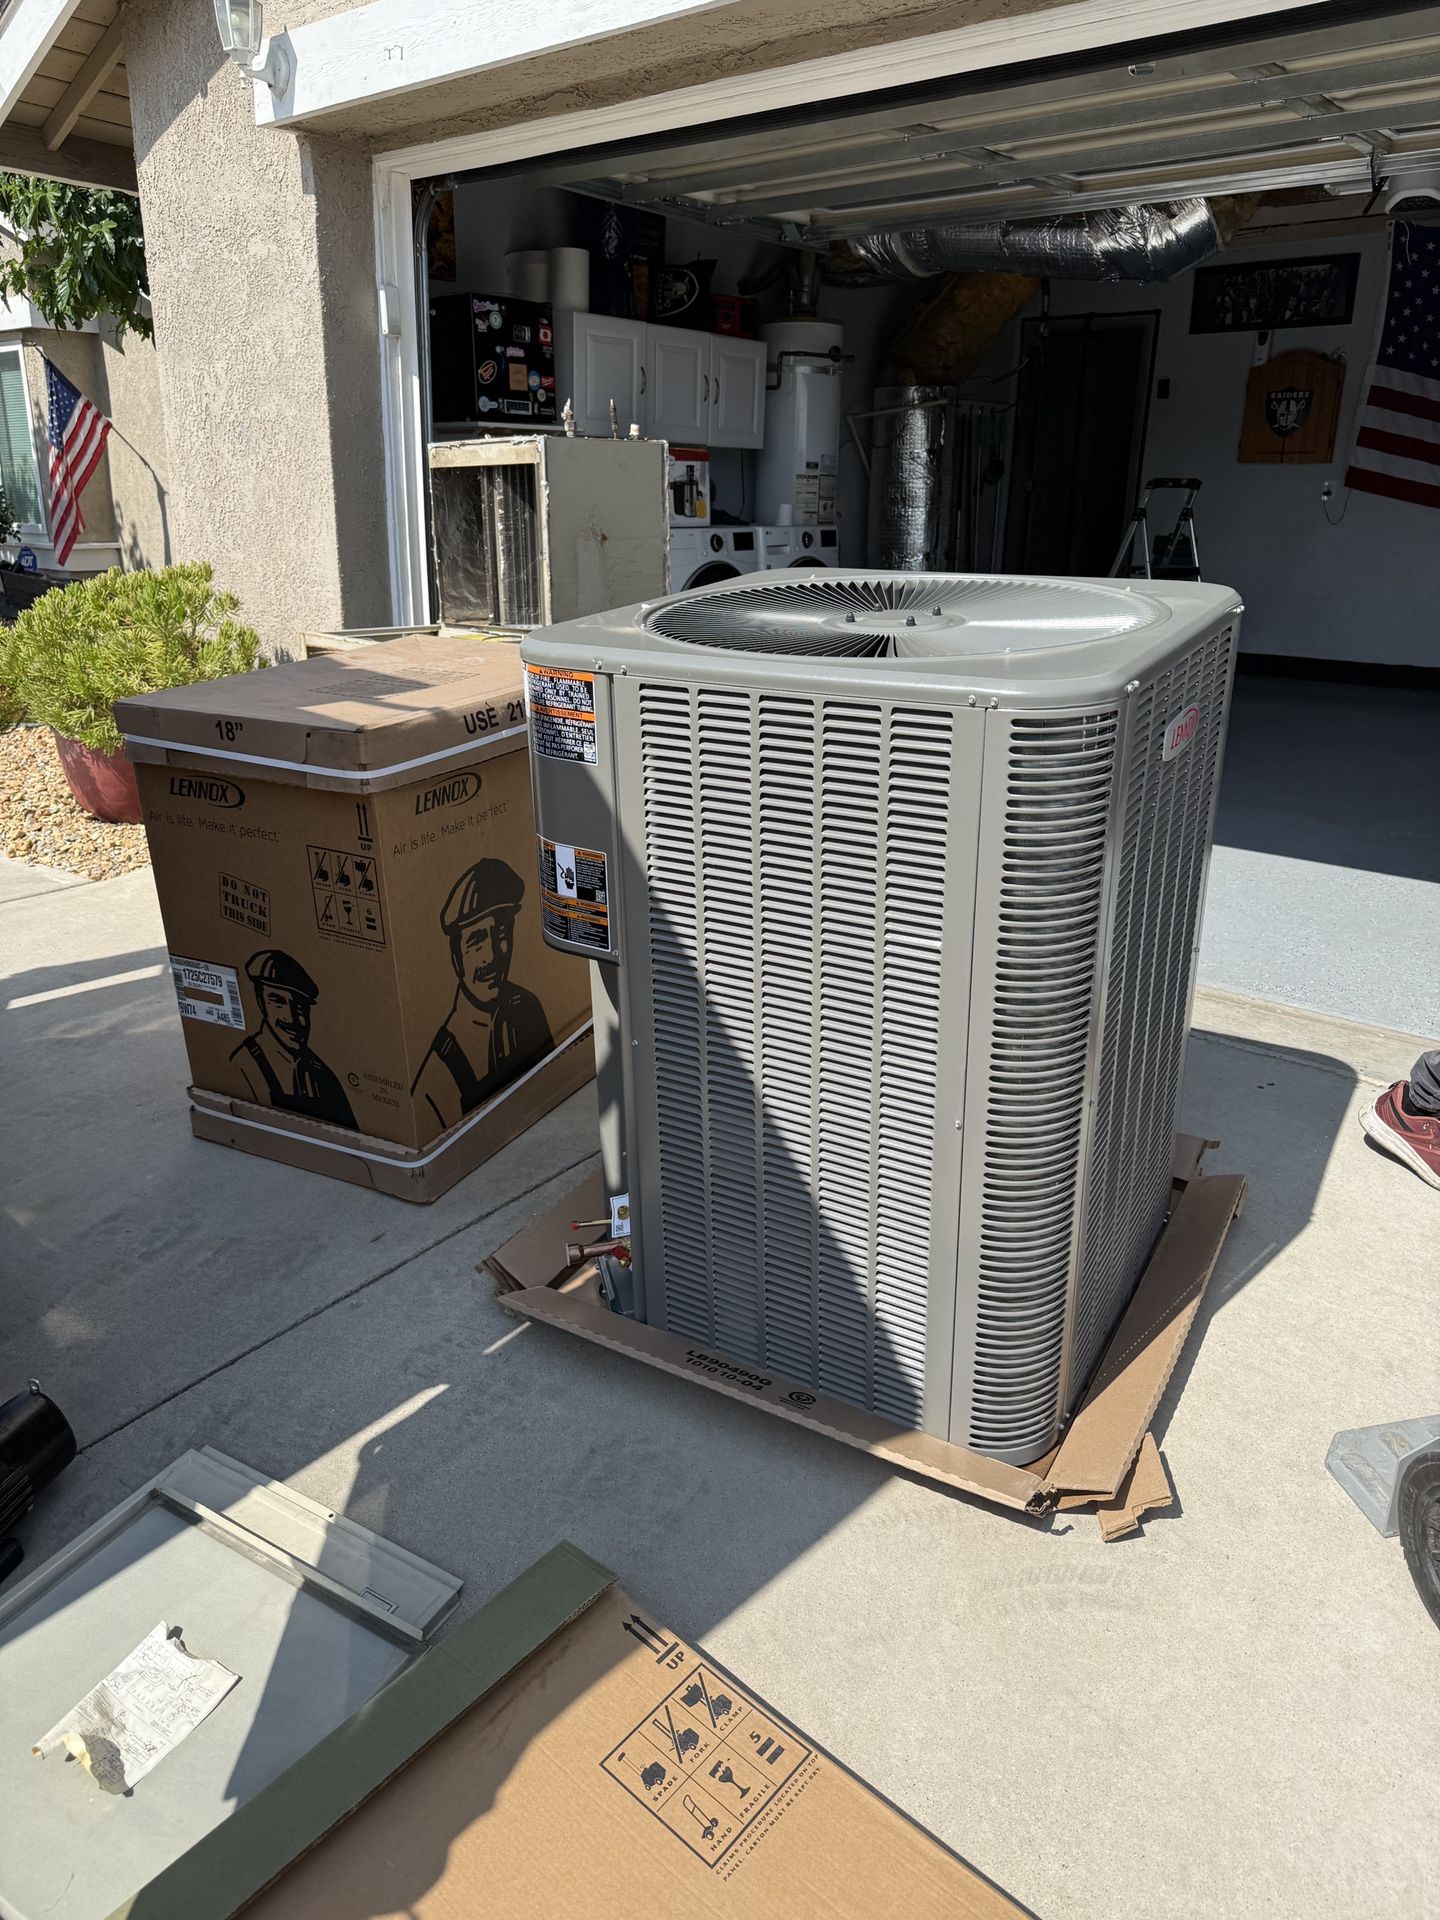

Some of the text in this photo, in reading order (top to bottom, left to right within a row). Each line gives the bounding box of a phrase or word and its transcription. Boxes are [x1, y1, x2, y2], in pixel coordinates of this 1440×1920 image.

[542, 668, 574, 679] WARNING
[553, 676, 585, 688] FLAMMABLE
[568, 691, 590, 700] TRAINED
[580, 686, 588, 694] BE
[463, 706, 500, 735] USE
[169, 776, 230, 804] LENNOX
[414, 776, 470, 816] LENNOX
[149, 809, 162, 823] Air
[166, 812, 174, 825] is
[198, 817, 226, 834] Make
[228, 821, 236, 834] it
[359, 842, 373, 852] UP
[393, 843, 407, 858] Air
[410, 838, 419, 851] is
[440, 822, 466, 839] Make
[467, 815, 474, 828] it
[222, 875, 268, 903] DO NOT
[222, 890, 268, 918] TRUCK
[222, 905, 268, 933] THIS SIDE
[182, 967, 223, 987] 1725C27579
[372, 1093, 400, 1108] MEXICO
[666, 1651, 685, 1670] UP
[720, 1706, 743, 1732] CLAMP
[749, 1730, 762, 1744] 5
[689, 1742, 710, 1763] FORK
[652, 1775, 679, 1802] SPADE
[739, 1783, 771, 1818] FRAGILE
[715, 1754, 819, 1875] CLAIMS PROCEDURE LOCATED ON TOP
[722, 1766, 822, 1882] PANEL. CARTON MUST BE KEPT DRY.
[710, 1826, 733, 1852] HAND
